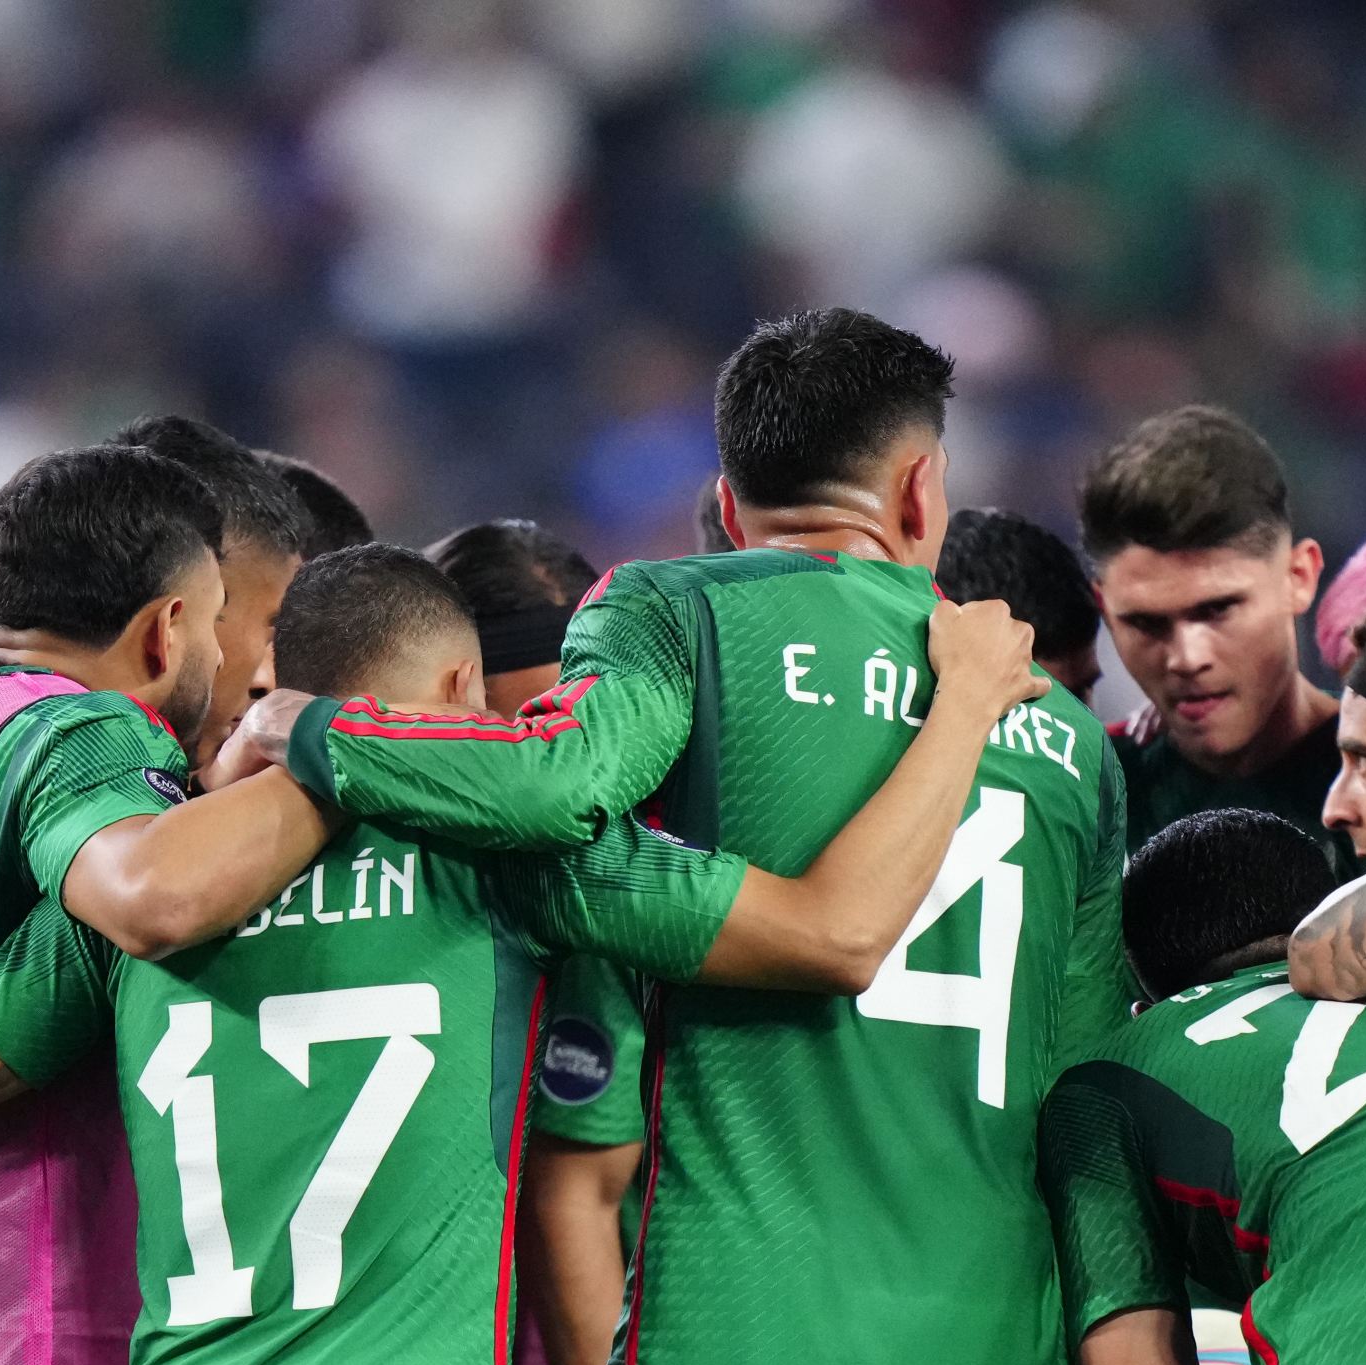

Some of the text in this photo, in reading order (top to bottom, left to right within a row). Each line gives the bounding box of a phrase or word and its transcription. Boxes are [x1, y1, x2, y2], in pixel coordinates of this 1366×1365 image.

[783, 643, 1081, 781] E. ÁLREZ
[856, 786, 1025, 1110] 4
[137, 983, 442, 1327] 17
